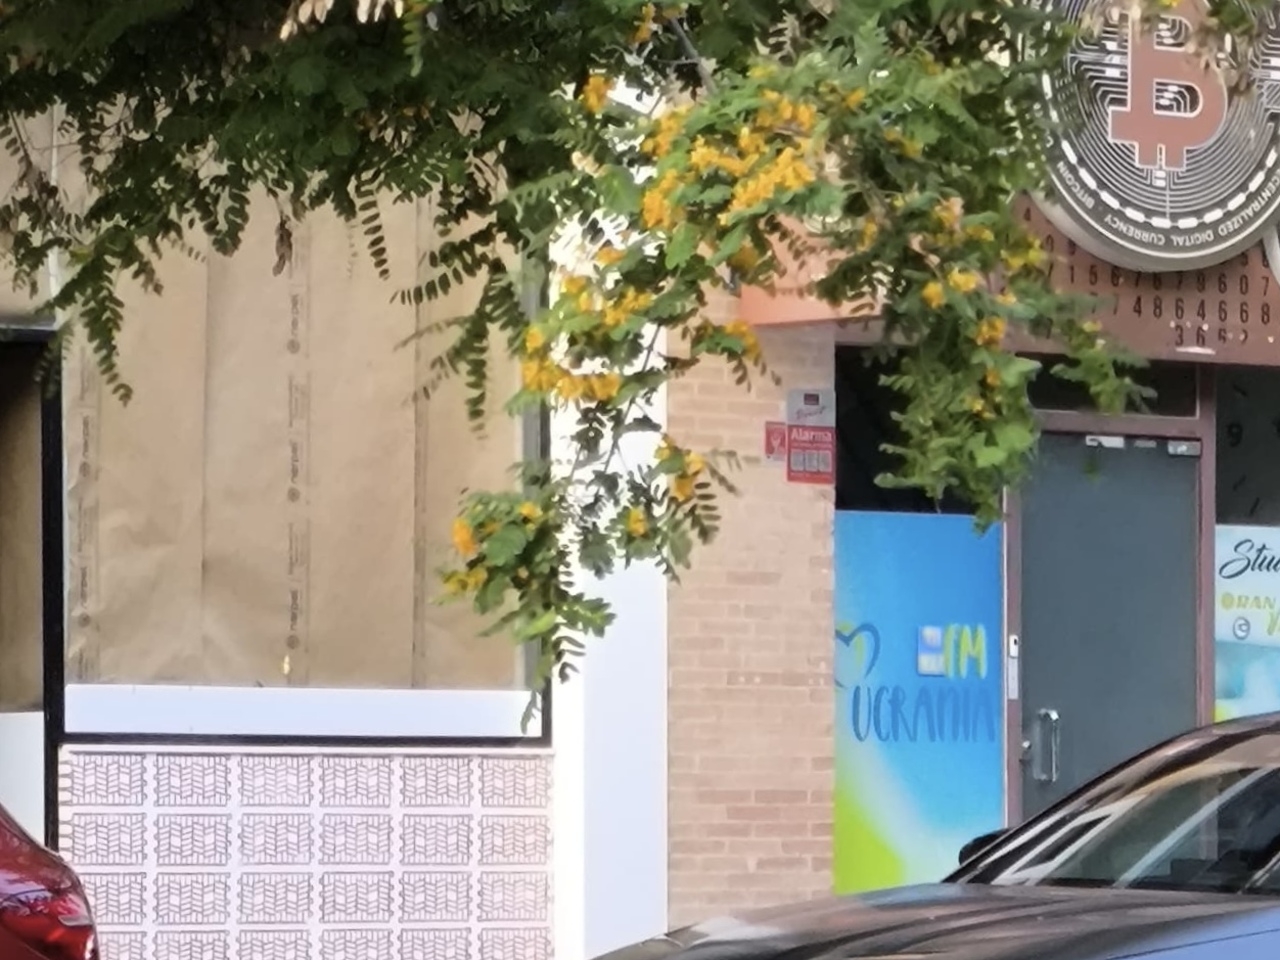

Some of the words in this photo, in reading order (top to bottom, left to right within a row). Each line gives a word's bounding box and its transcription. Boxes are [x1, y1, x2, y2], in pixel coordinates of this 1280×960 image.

[1056, 161, 1095, 209] BITCOIN
[1104, 213, 1166, 245] CURRENCY
[1171, 229, 1214, 246] DIGITAL
